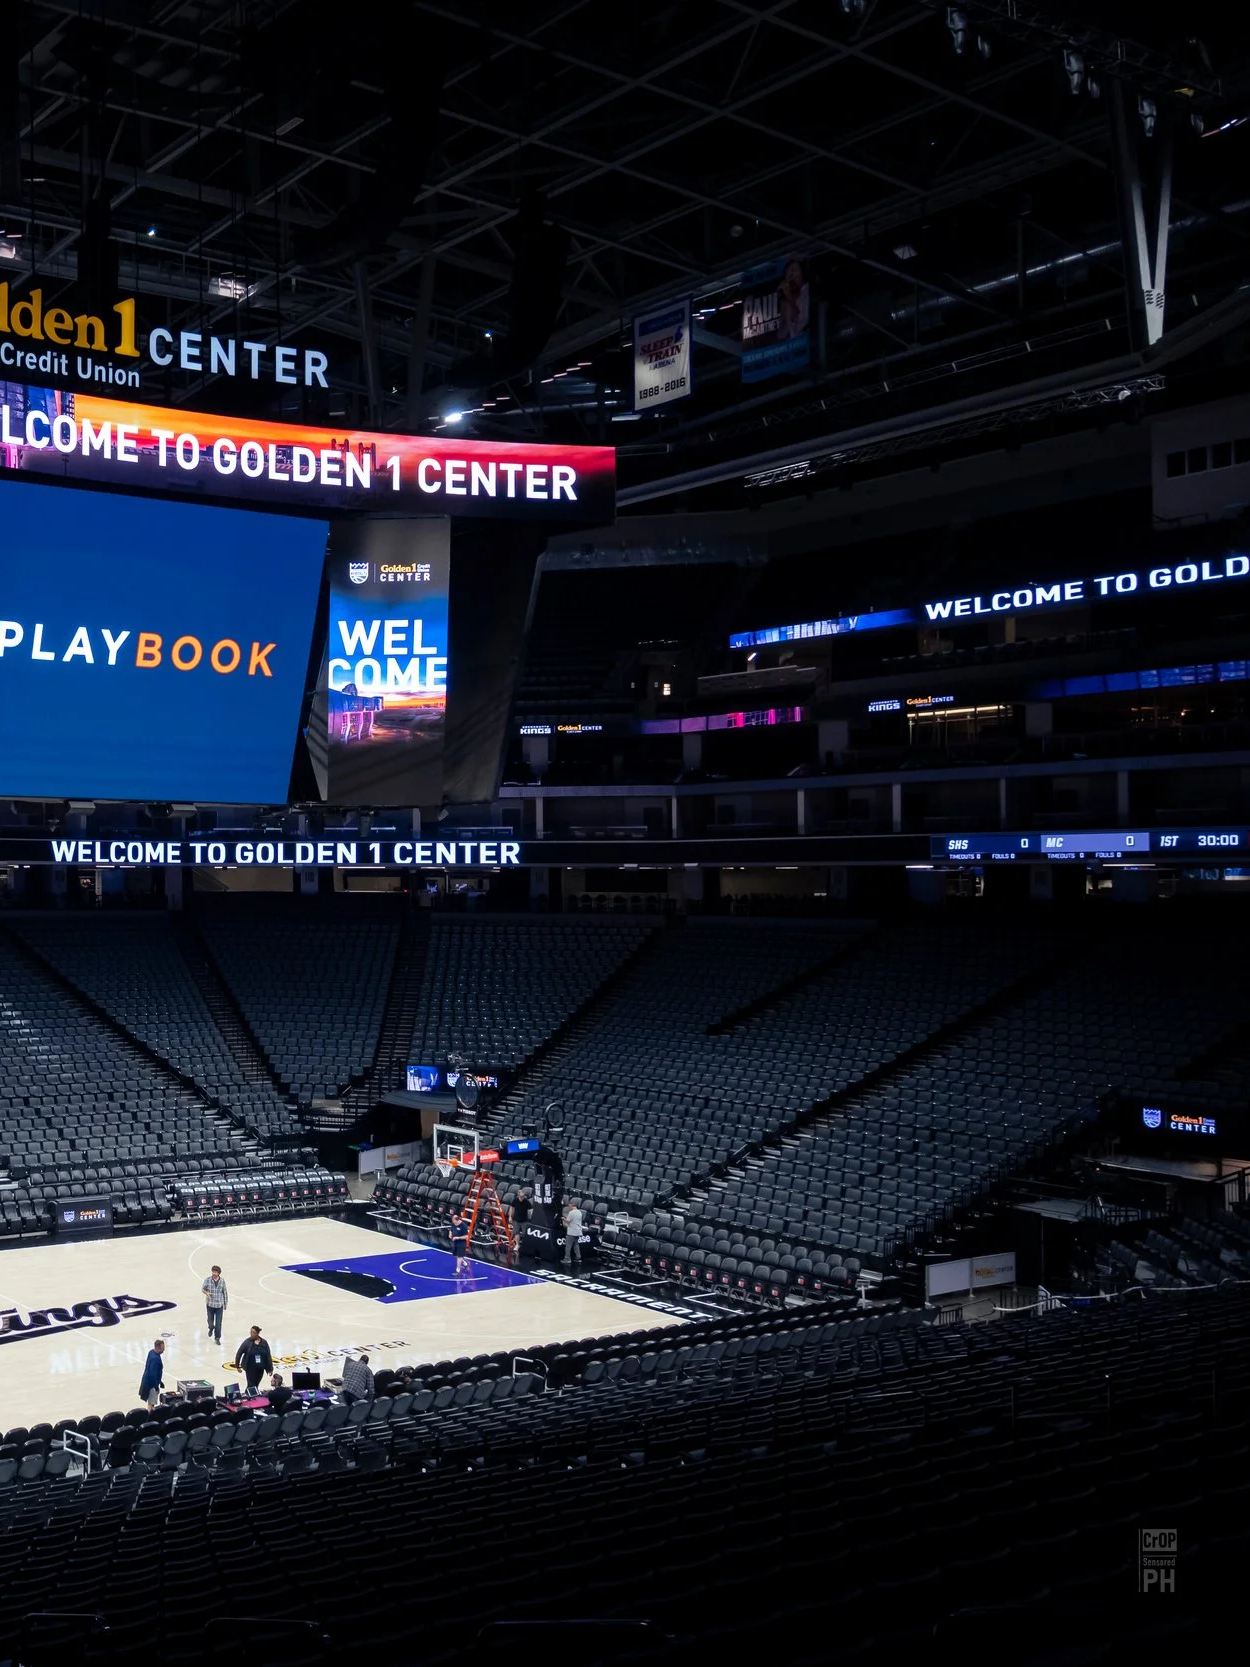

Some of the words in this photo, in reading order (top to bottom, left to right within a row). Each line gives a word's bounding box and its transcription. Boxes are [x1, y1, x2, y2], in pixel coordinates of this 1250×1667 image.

[743, 292, 780, 329] PAUL
[640, 337, 674, 357] SLEEP
[648, 343, 684, 364] TRAIN
[0, 342, 68, 376] Credit
[77, 358, 140, 388] Union
[149, 328, 329, 388] CENTER
[640, 378, 686, 400] 1988-2016
[150, 429, 199, 470] TO
[213, 438, 371, 489] GOLDEN
[386, 456, 401, 491] 1
[418, 458, 577, 500] CENTER
[380, 573, 431, 582] CENTER
[925, 580, 1084, 620] WELCOME
[1093, 573, 1137, 596] TO
[1149, 556, 1250, 588] GOLD
[338, 620, 438, 655] WEL
[328, 657, 447, 693] COME
[868, 702, 901, 712] KINGS
[520, 727, 551, 735] KINGS
[948, 839, 969, 850] SHS
[1020, 838, 1029, 848] 0
[1046, 837, 1064, 848] MC
[1126, 836, 1134, 846] 0
[1160, 835, 1179, 847] 1ST
[1198, 834, 1239, 846] 30:00
[51, 840, 181, 863] WELCOME
[189, 843, 226, 864] TO
[235, 843, 357, 864] GOLDEN
[369, 843, 381, 864] 1
[393, 843, 520, 864] CENTER
[1170, 1122, 1216, 1134] CENTER
[557, 1235, 591, 1246] coase
[529, 1269, 714, 1322] SACRAMENT
[328, 1340, 411, 1357] CENTER
